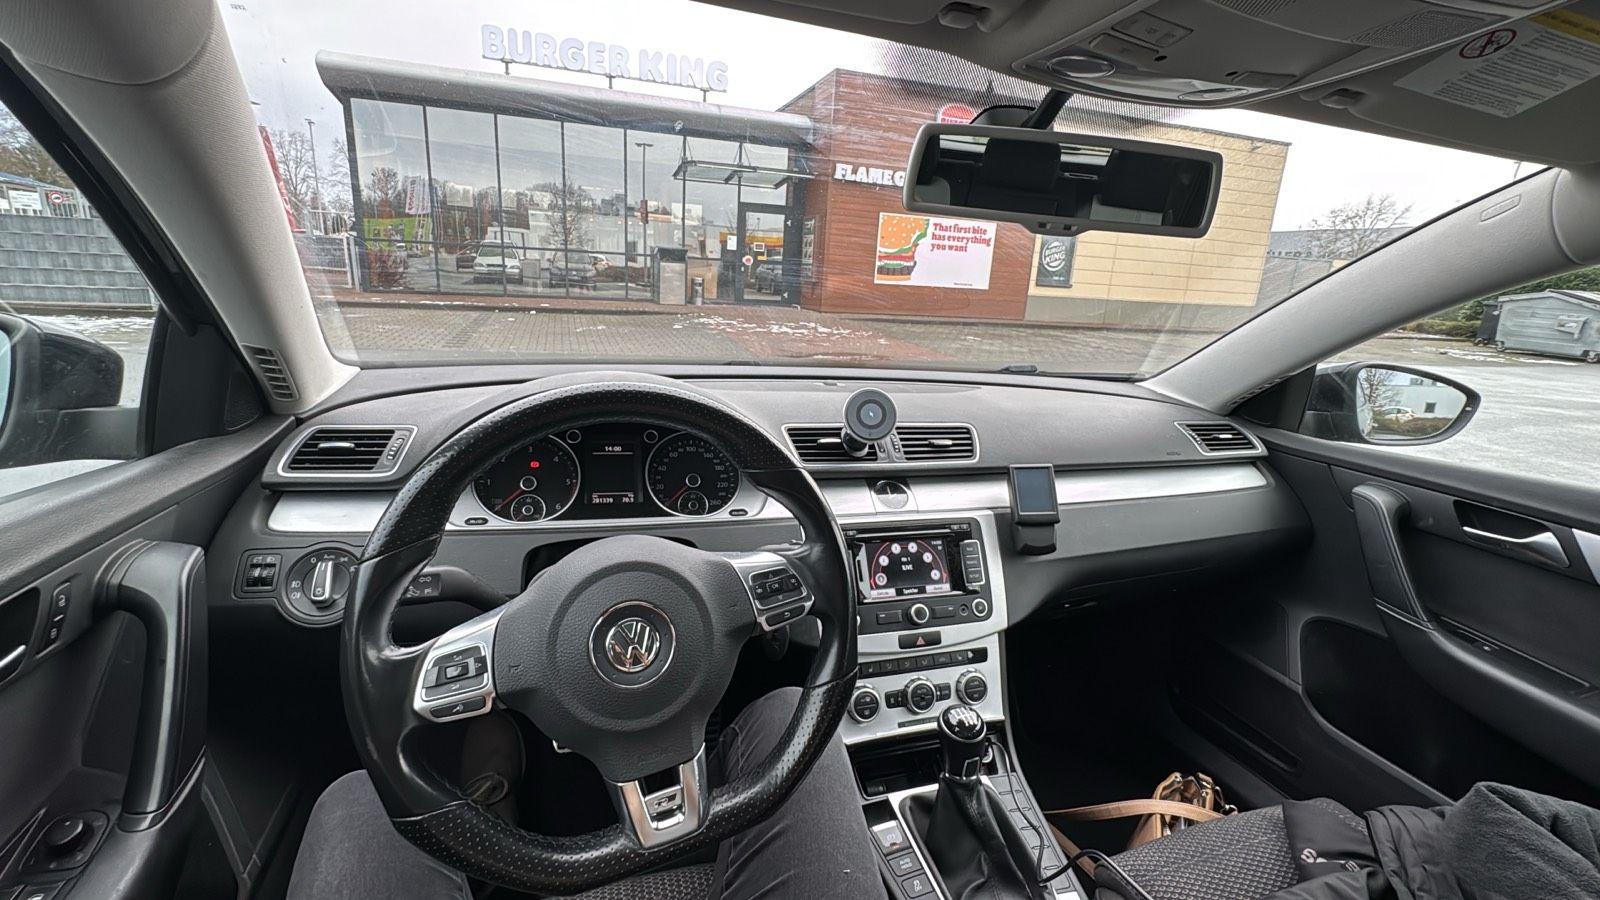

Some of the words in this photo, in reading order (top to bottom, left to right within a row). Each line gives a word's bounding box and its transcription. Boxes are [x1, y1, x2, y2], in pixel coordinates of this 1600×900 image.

[481, 24, 631, 78] BURGER
[639, 49, 729, 91] KING
[933, 223, 952, 232] That
[953, 224, 971, 234] first
[972, 226, 987, 235] bite
[931, 232, 946, 241] has
[947, 235, 992, 247] everything
[930, 243, 946, 252] you
[948, 244, 968, 252] want
[1045, 251, 1066, 263] KING
